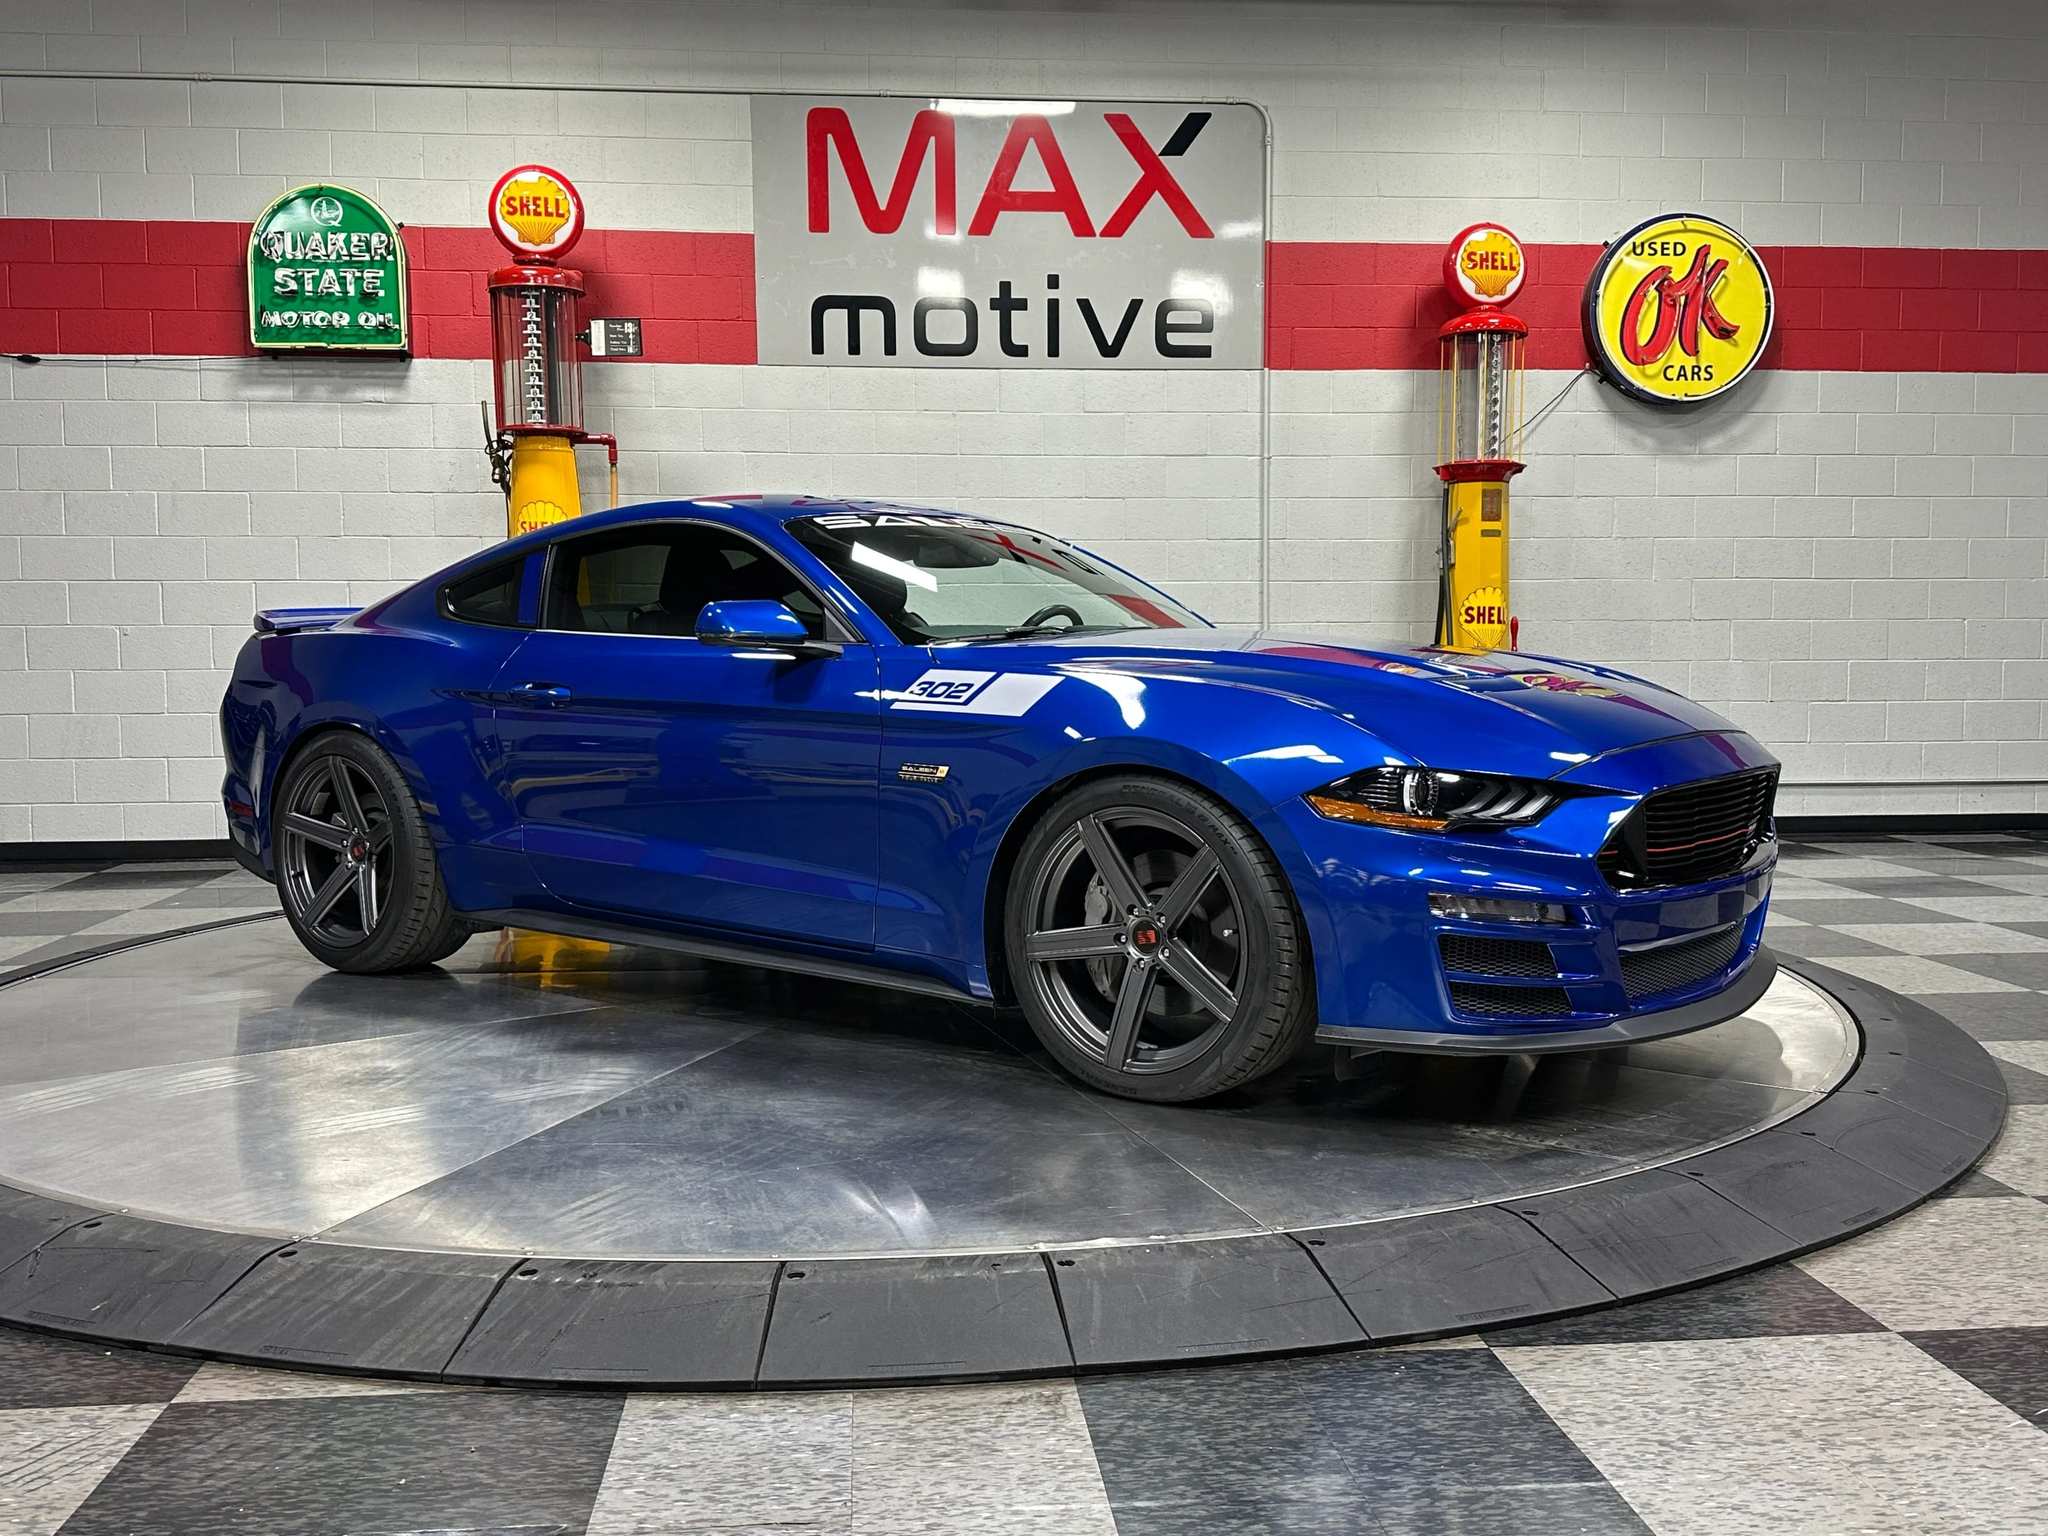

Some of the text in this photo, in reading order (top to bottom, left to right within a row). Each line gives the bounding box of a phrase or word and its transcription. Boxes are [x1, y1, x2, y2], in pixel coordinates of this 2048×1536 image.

[806, 107, 1215, 239] MAX
[506, 196, 565, 218] SHELL
[260, 230, 395, 263] QUAKER
[1632, 242, 1687, 257] USED
[1466, 251, 1517, 271] SHELL
[274, 268, 385, 297] STATE
[1620, 244, 1740, 366] OK
[261, 311, 399, 329] MOTOR OIL
[811, 274, 1215, 359] motive
[1663, 365, 1714, 381] CARS
[908, 680, 975, 699] 302
[1121, 784, 1183, 807] GENERAL
